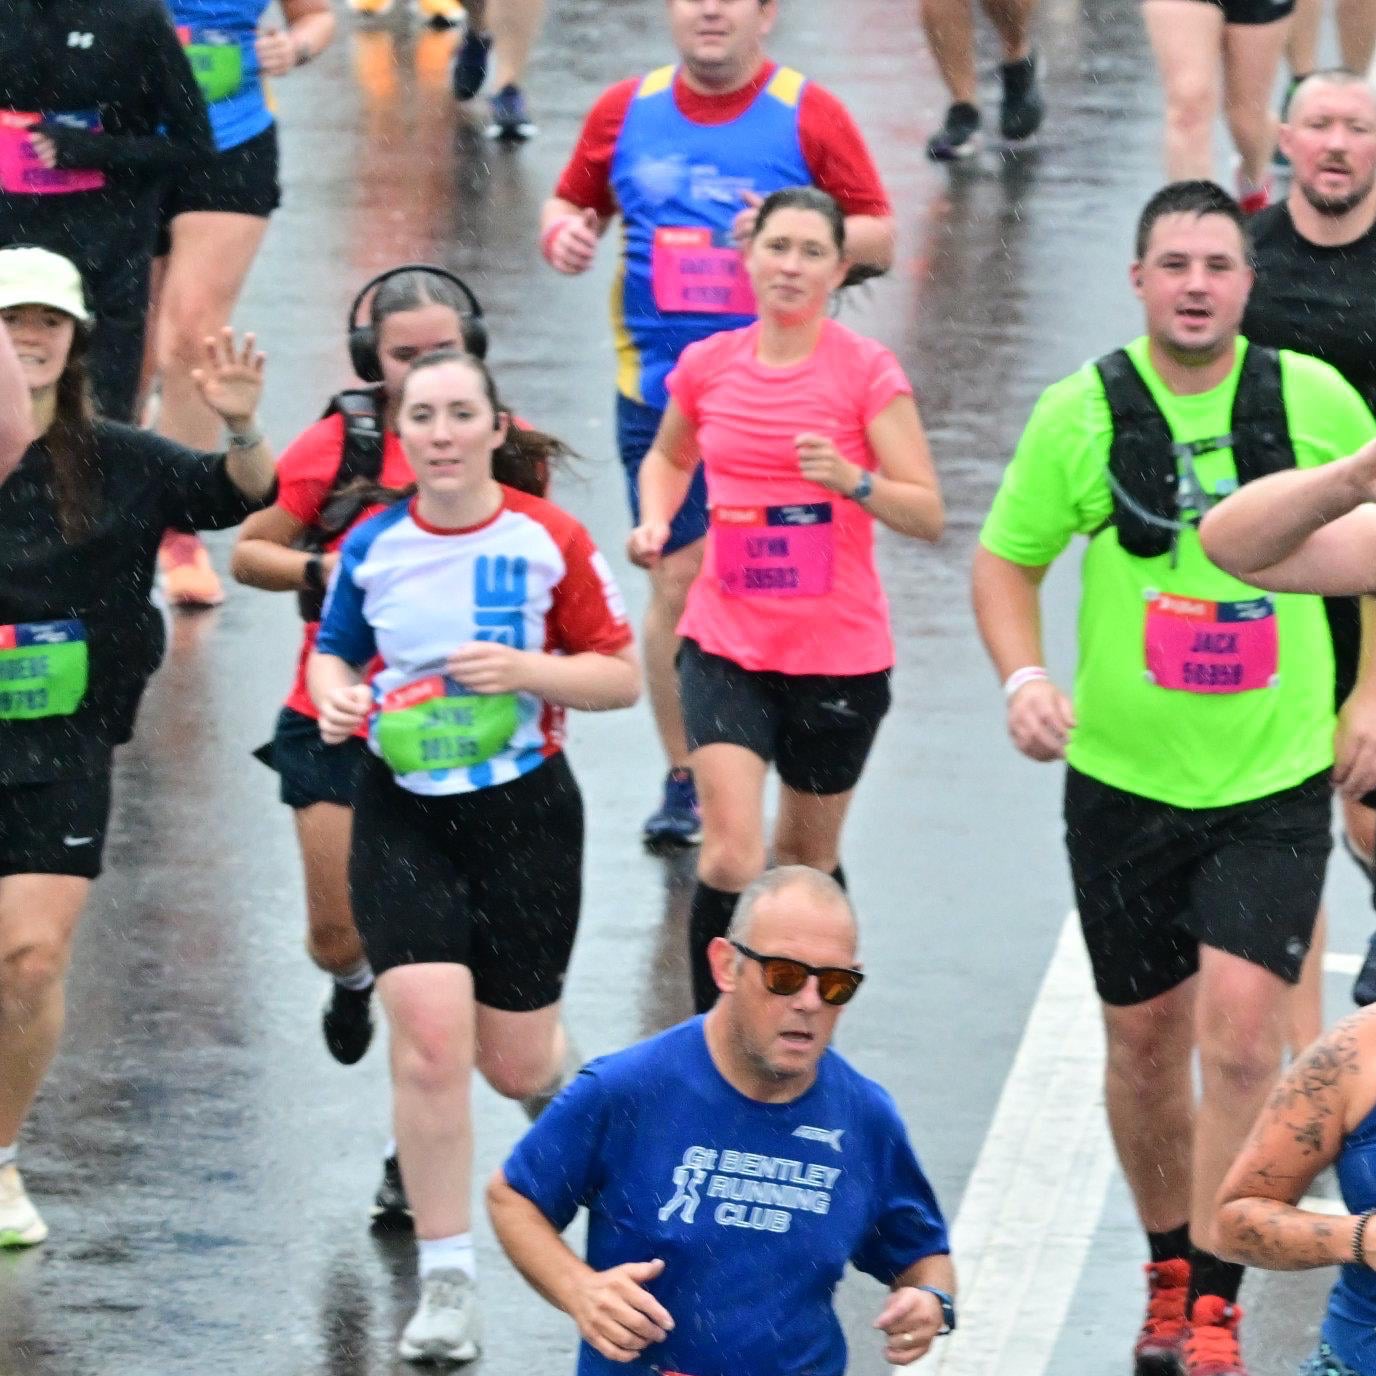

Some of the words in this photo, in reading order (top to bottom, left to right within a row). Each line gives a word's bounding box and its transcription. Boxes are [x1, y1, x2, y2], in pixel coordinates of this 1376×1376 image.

[718, 1149, 842, 1189] BENTLEY
[706, 1174, 832, 1215] RUNNING
[714, 1202, 793, 1233] CLUB
